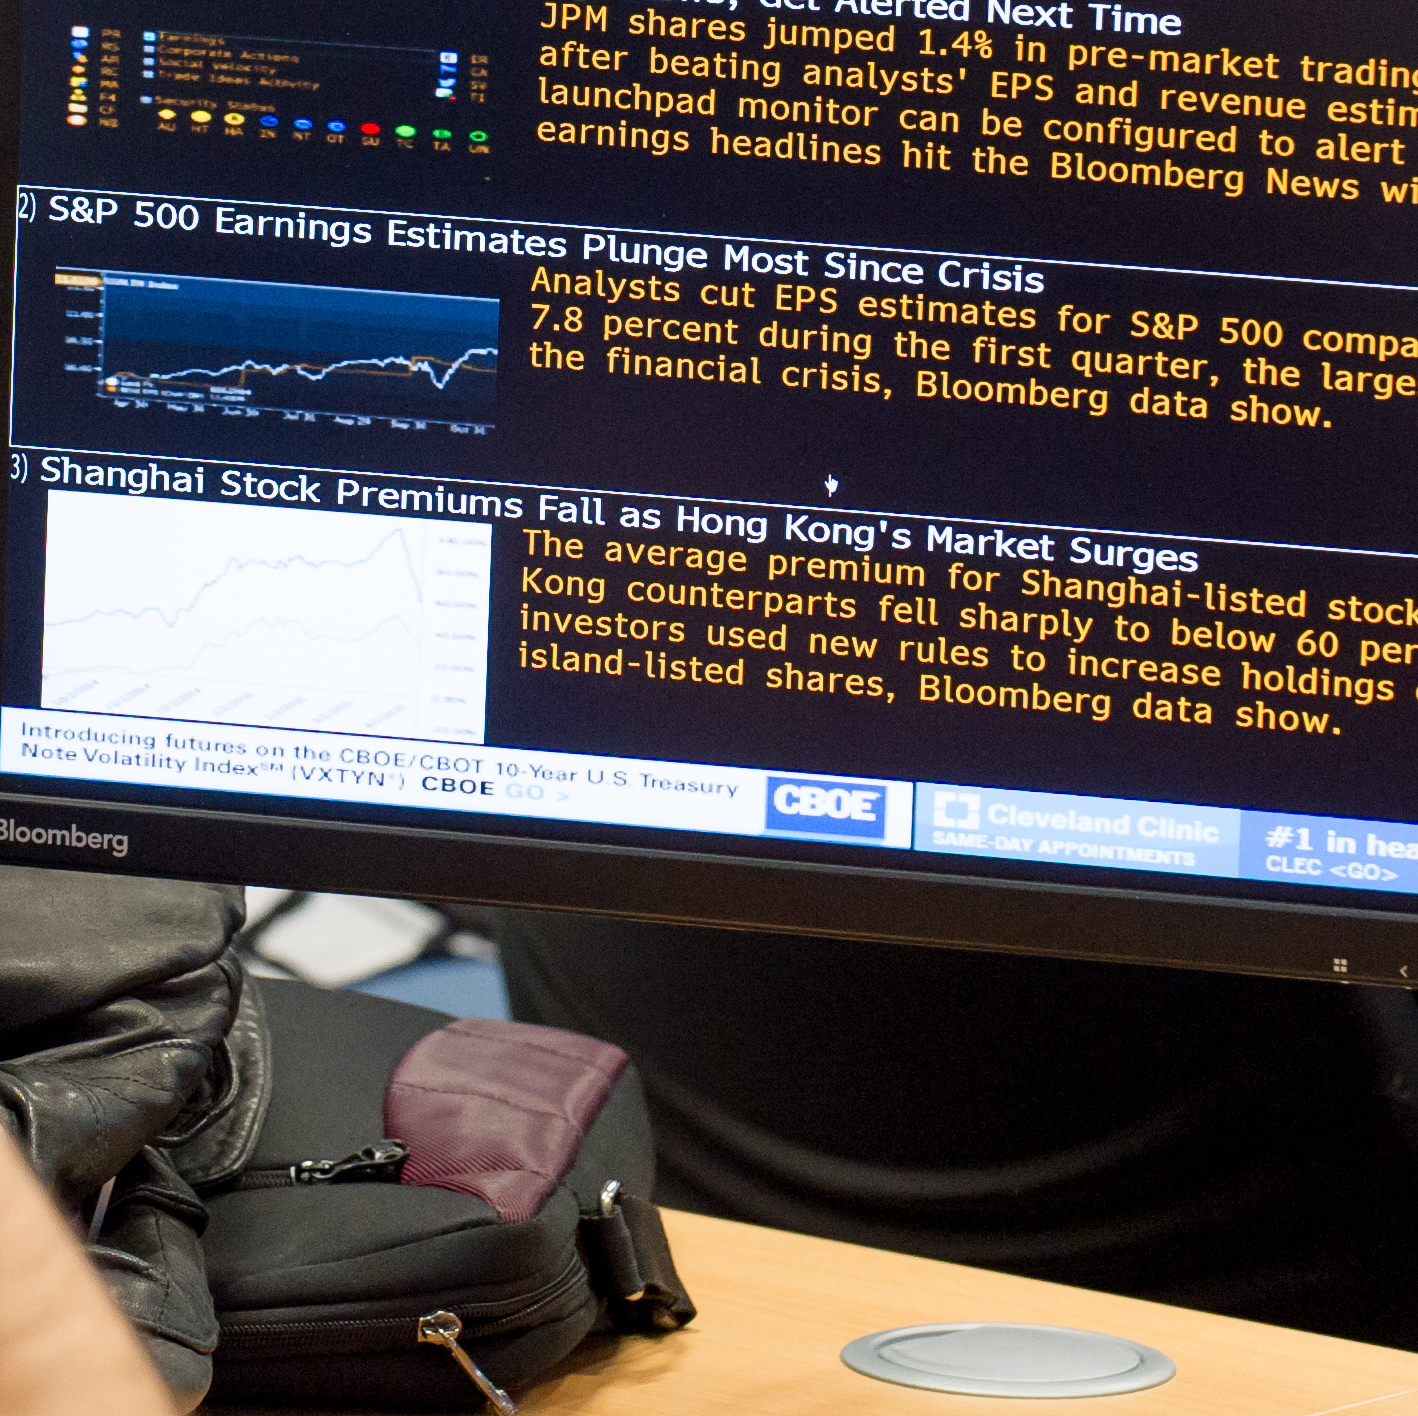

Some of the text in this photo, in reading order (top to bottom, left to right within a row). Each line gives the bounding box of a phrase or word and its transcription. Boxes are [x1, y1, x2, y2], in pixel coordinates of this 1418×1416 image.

[540, 1, 608, 32] JPM
[628, 7, 746, 42] shares
[763, 16, 895, 55] jumped
[919, 28, 993, 59] 1.4%
[1015, 33, 1046, 63] in
[1068, 44, 1280, 79] pre-market
[1087, 3, 1182, 36] Time
[18, 192, 1045, 294] 2) S&P 500 Earnings Estimates Plunge Most Since Crisis
[529, 341, 1332, 428] the financial crisis, Bloomberg data show.
[10, 452, 1199, 575] 3) Shanghai Stock Premiums Fall as Hong Kong's Market Surges
[21, 722, 157, 750] Introducing
[165, 733, 248, 757] futures
[255, 742, 285, 758] on
[293, 745, 332, 763] the
[339, 745, 486, 777] CBOE/CBOT
[496, 761, 579, 784] 10-Year
[641, 772, 739, 800] Treasury
[21, 742, 496, 797] Note Volatility CBOE
[773, 782, 881, 824] CBOE
[986, 802, 1221, 844] Cleveland Clinic
[932, 830, 1197, 868] SAME-DAY APPOINTMENTS
[1264, 824, 1314, 854] #1
[1326, 829, 1357, 856] in
[1265, 854, 1323, 878] CLEC
